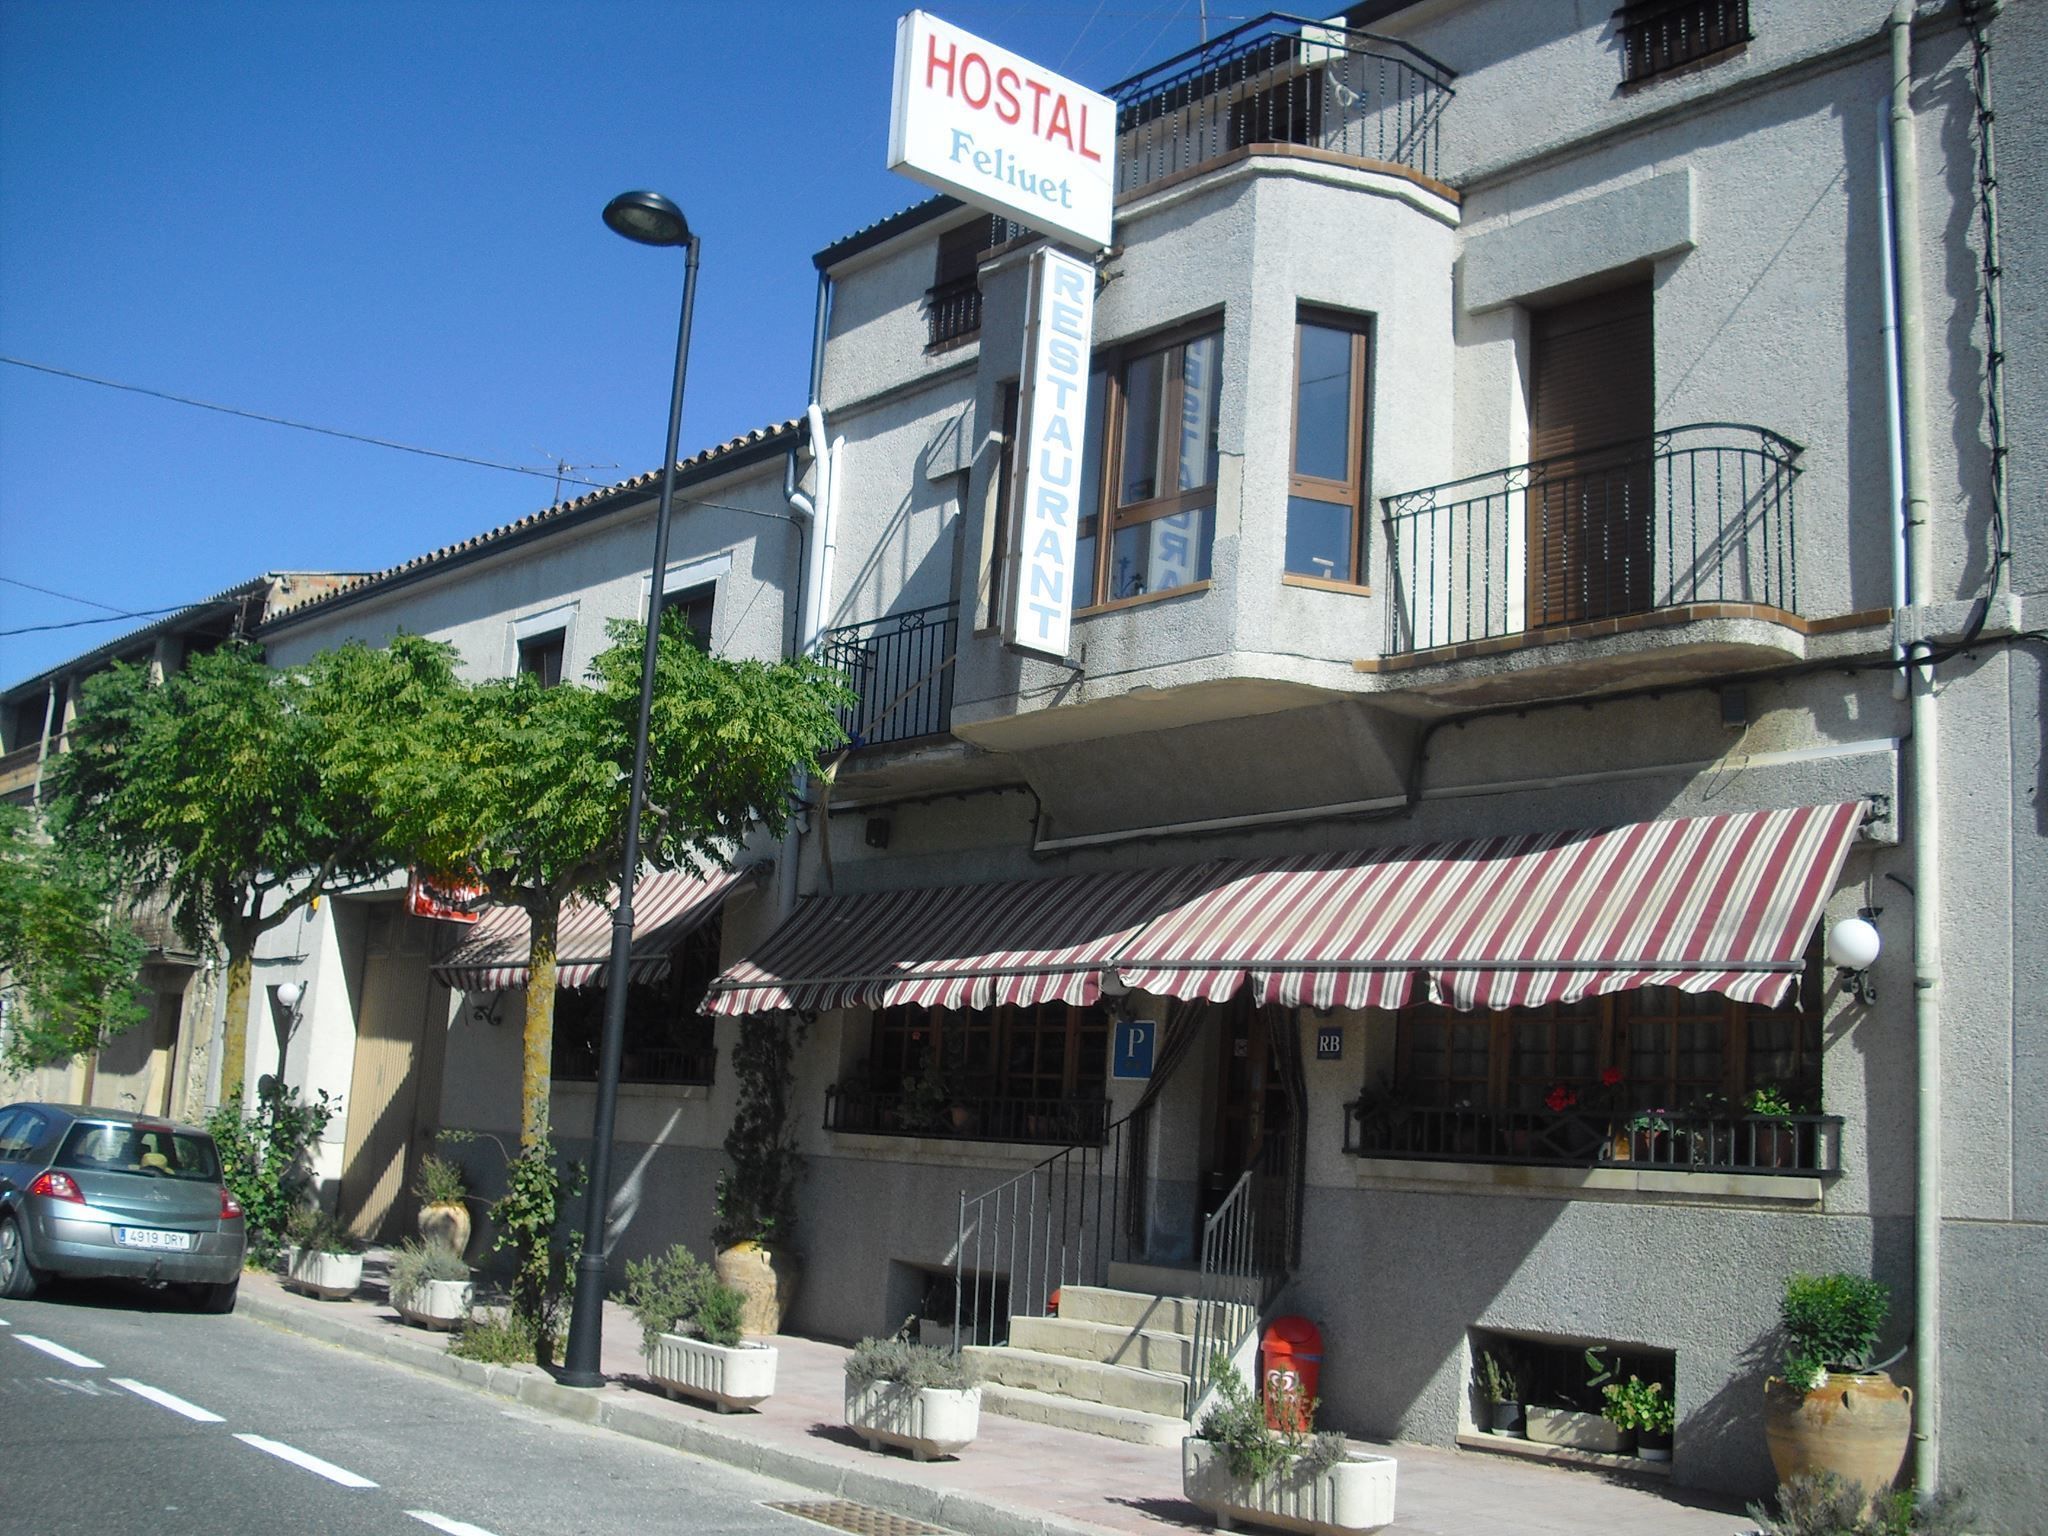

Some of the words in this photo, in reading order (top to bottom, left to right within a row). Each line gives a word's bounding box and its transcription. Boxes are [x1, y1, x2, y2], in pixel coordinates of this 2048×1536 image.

[926, 34, 1101, 162] HOSTAL
[949, 128, 1072, 208] Feliuet
[1028, 265, 1085, 640] RESTAURANT
[1127, 1028, 1144, 1057] P
[1319, 1035, 1340, 1052] RB
[130, 1231, 158, 1244] 4919
[165, 1233, 185, 1246] DRY
